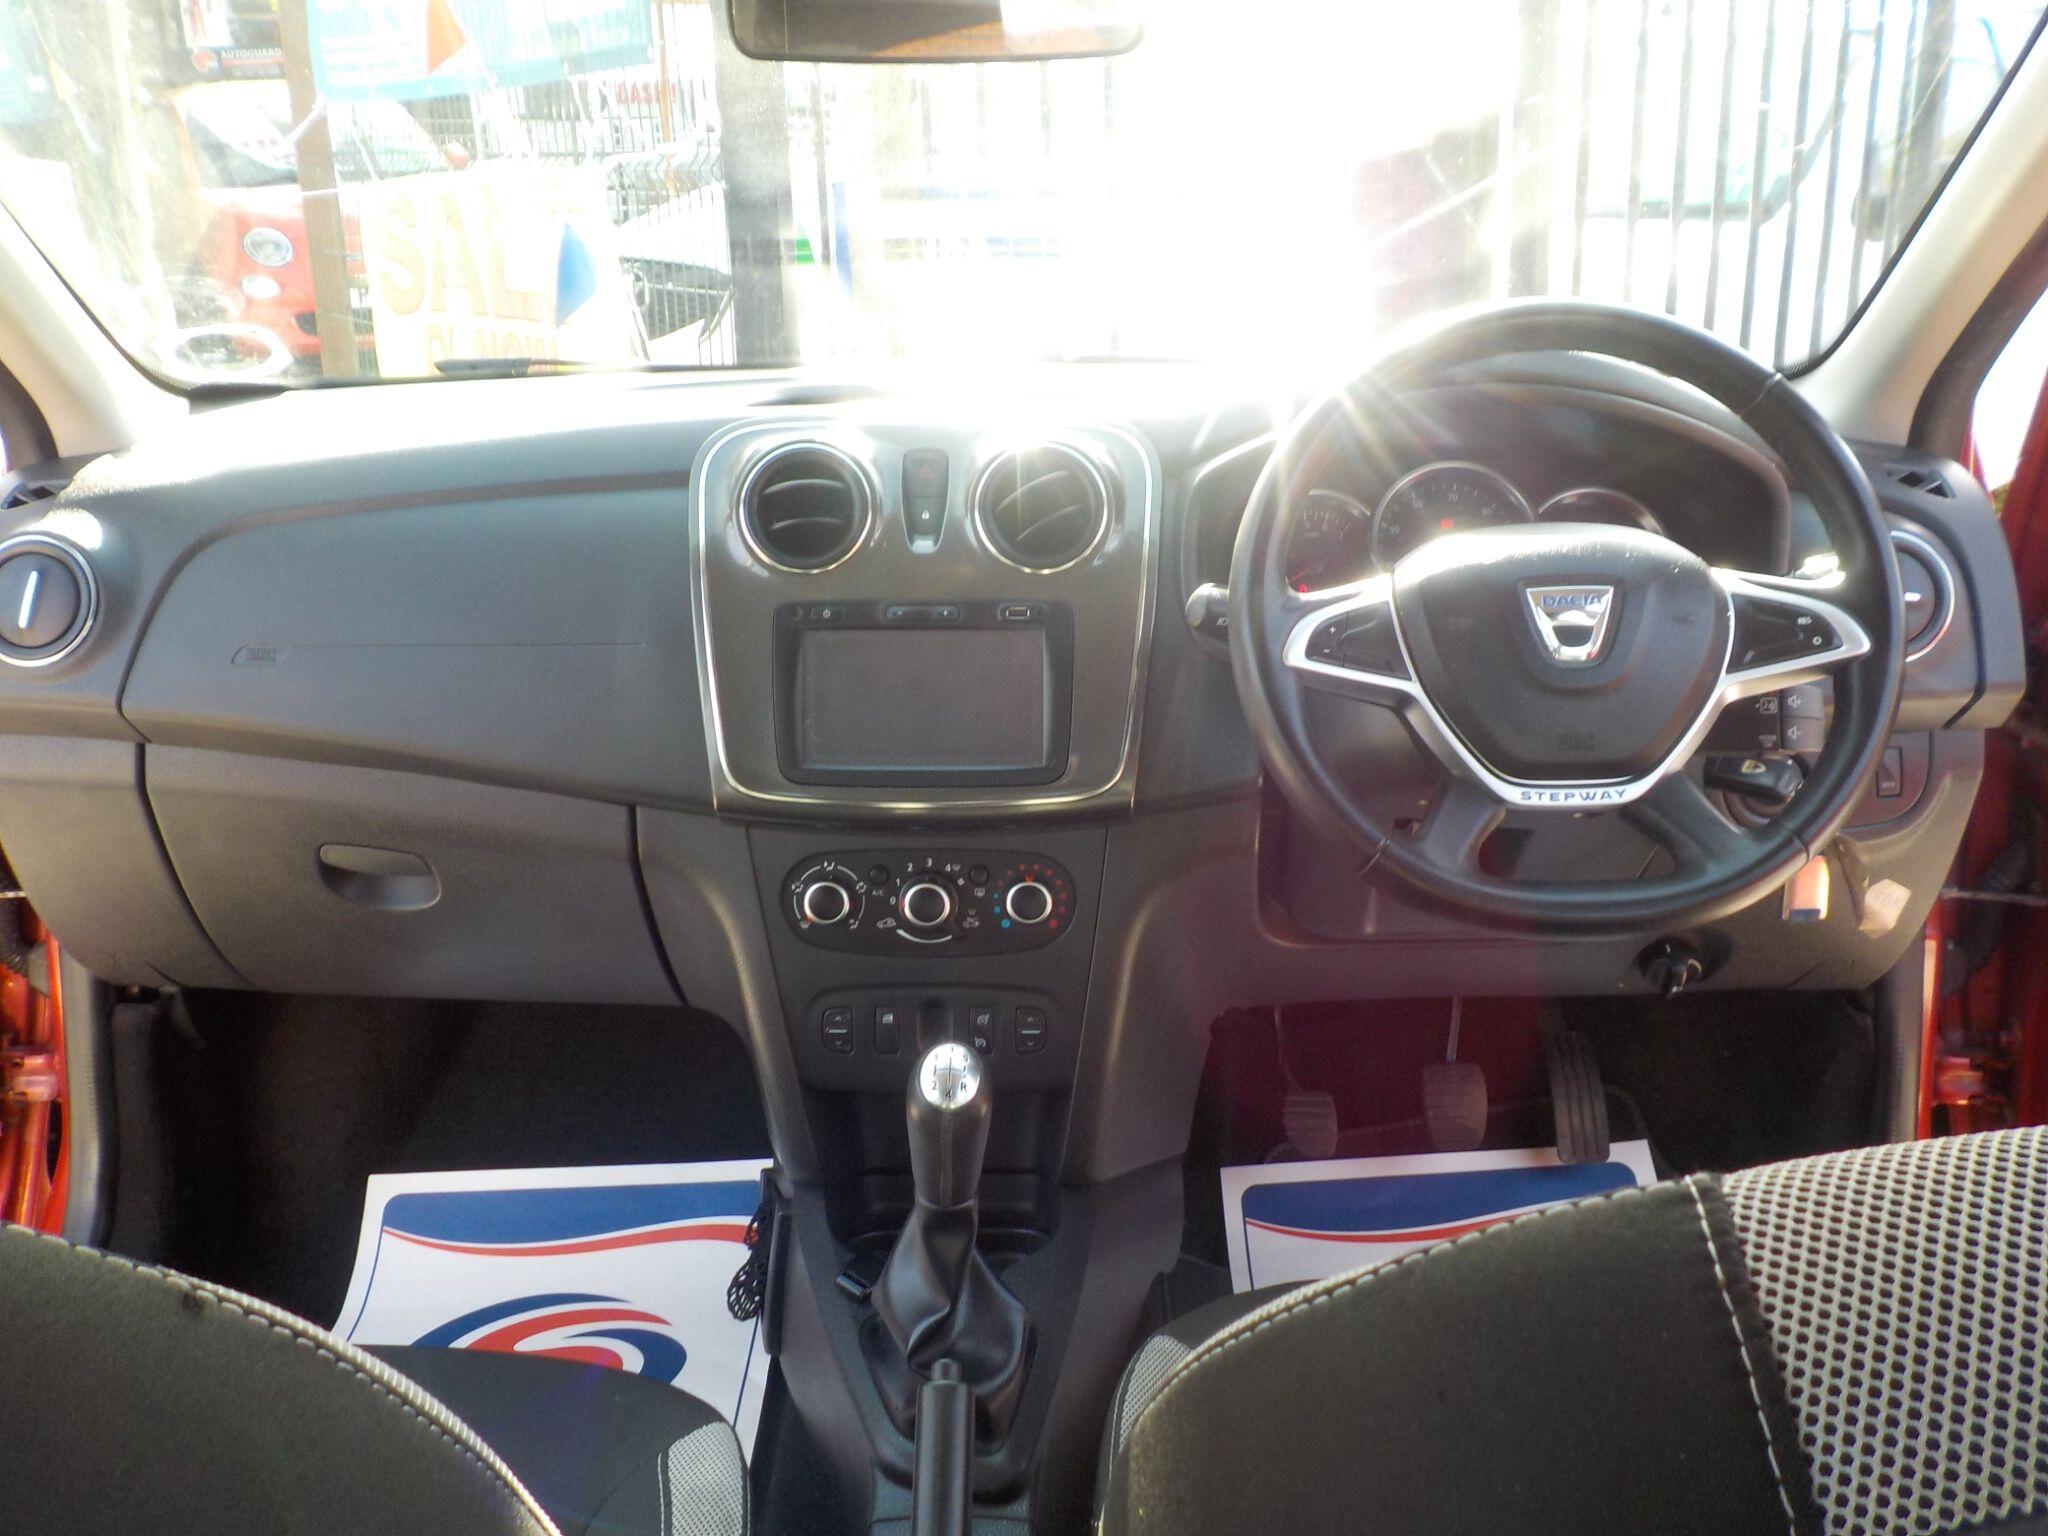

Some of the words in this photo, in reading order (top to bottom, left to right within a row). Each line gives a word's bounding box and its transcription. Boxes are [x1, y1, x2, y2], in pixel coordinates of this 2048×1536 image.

[220, 47, 282, 59] AUTOGUARD
[378, 178, 557, 323] SAL
[1542, 593, 1602, 608] DACIA
[1521, 789, 1626, 802] STEPWAY
[907, 863, 914, 872] 2
[926, 858, 933, 867] 3
[944, 863, 951, 872] 4
[896, 878, 901, 887] 1
[871, 889, 885, 897] A/C
[931, 1081, 938, 1091] 2
[960, 1081, 968, 1093] R
[945, 1089, 953, 1103] 4
